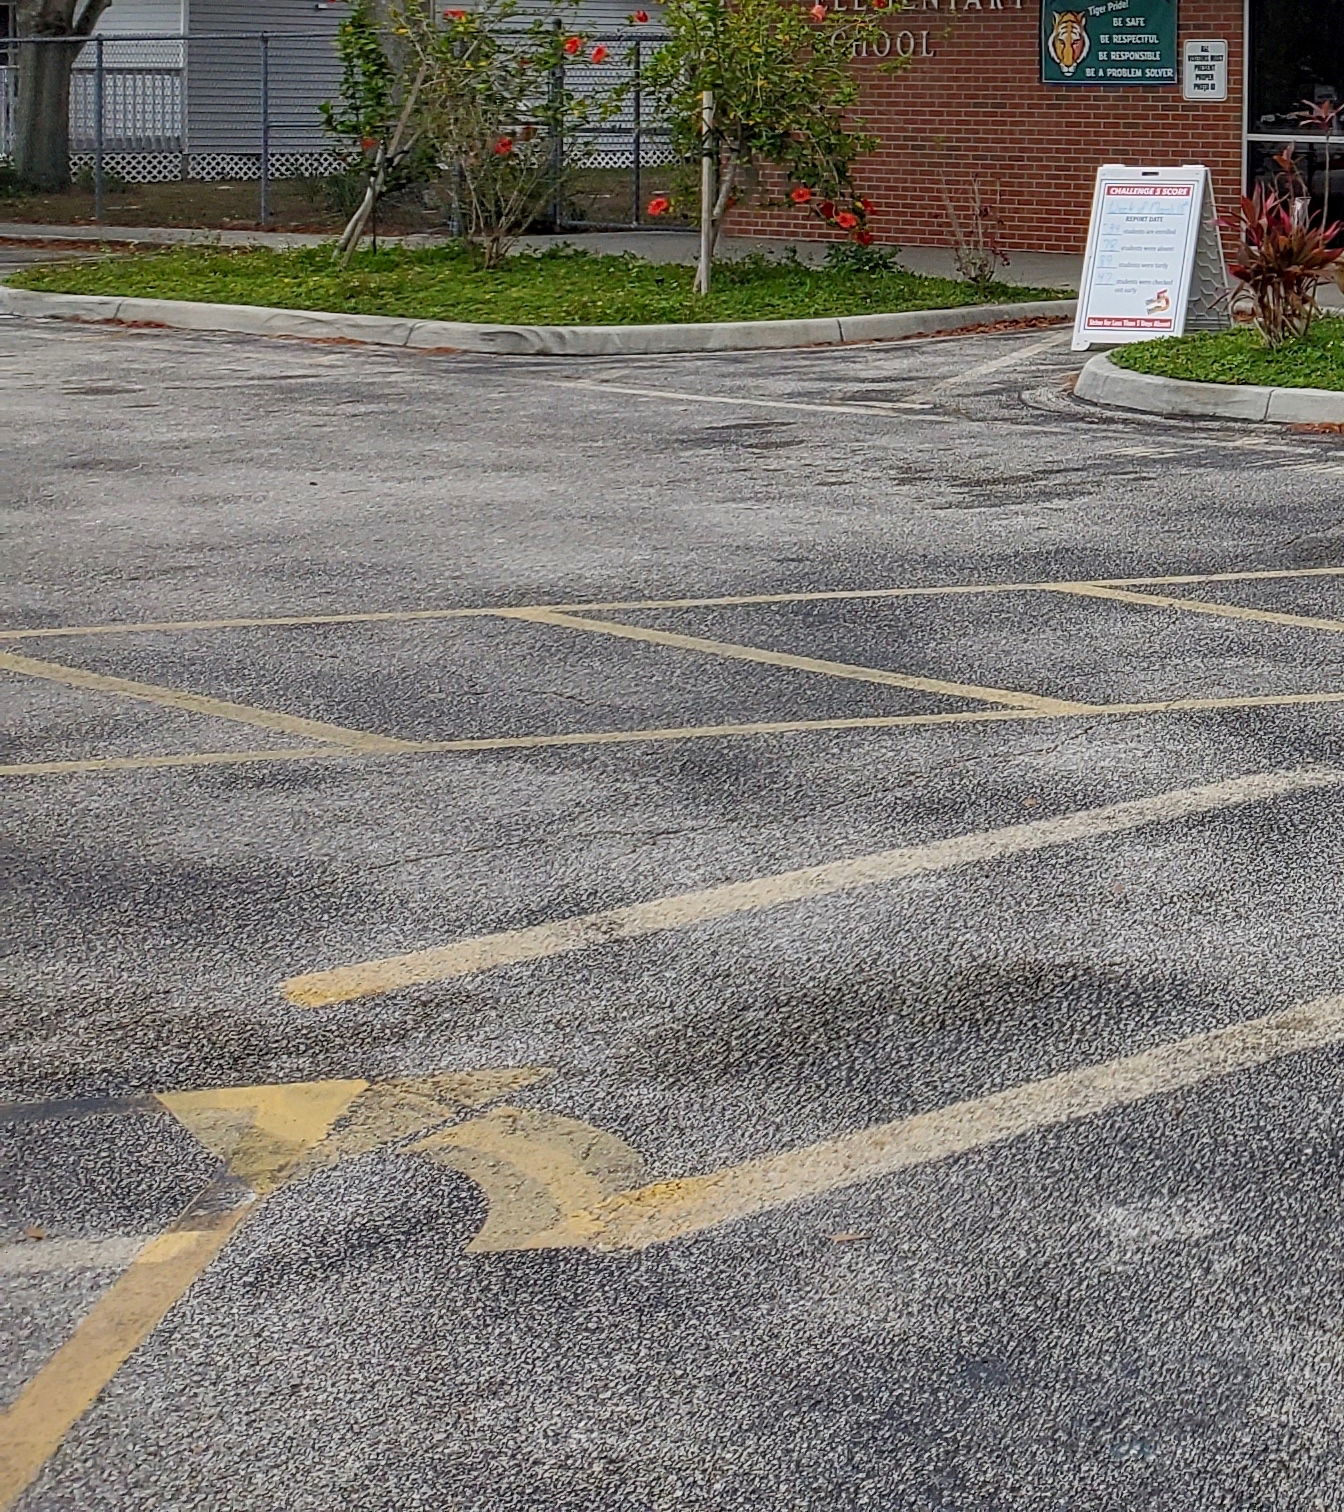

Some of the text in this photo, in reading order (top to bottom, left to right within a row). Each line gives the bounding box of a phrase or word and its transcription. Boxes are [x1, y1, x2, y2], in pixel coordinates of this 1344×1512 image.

[1088, 0, 1130, 17] Tiger Pride!
[1112, 17, 1146, 27] BE SAFE
[830, 29, 937, 58] CHOOL
[1099, 34, 1160, 44] BE RESPECTFUL
[1098, 51, 1161, 61] BE RESPONSIBLE
[1085, 68, 1174, 77] BE A PROBLEM SOLVER
[1109, 187, 1154, 196] CHALLENGE
[1161, 187, 1188, 196] SCORE
